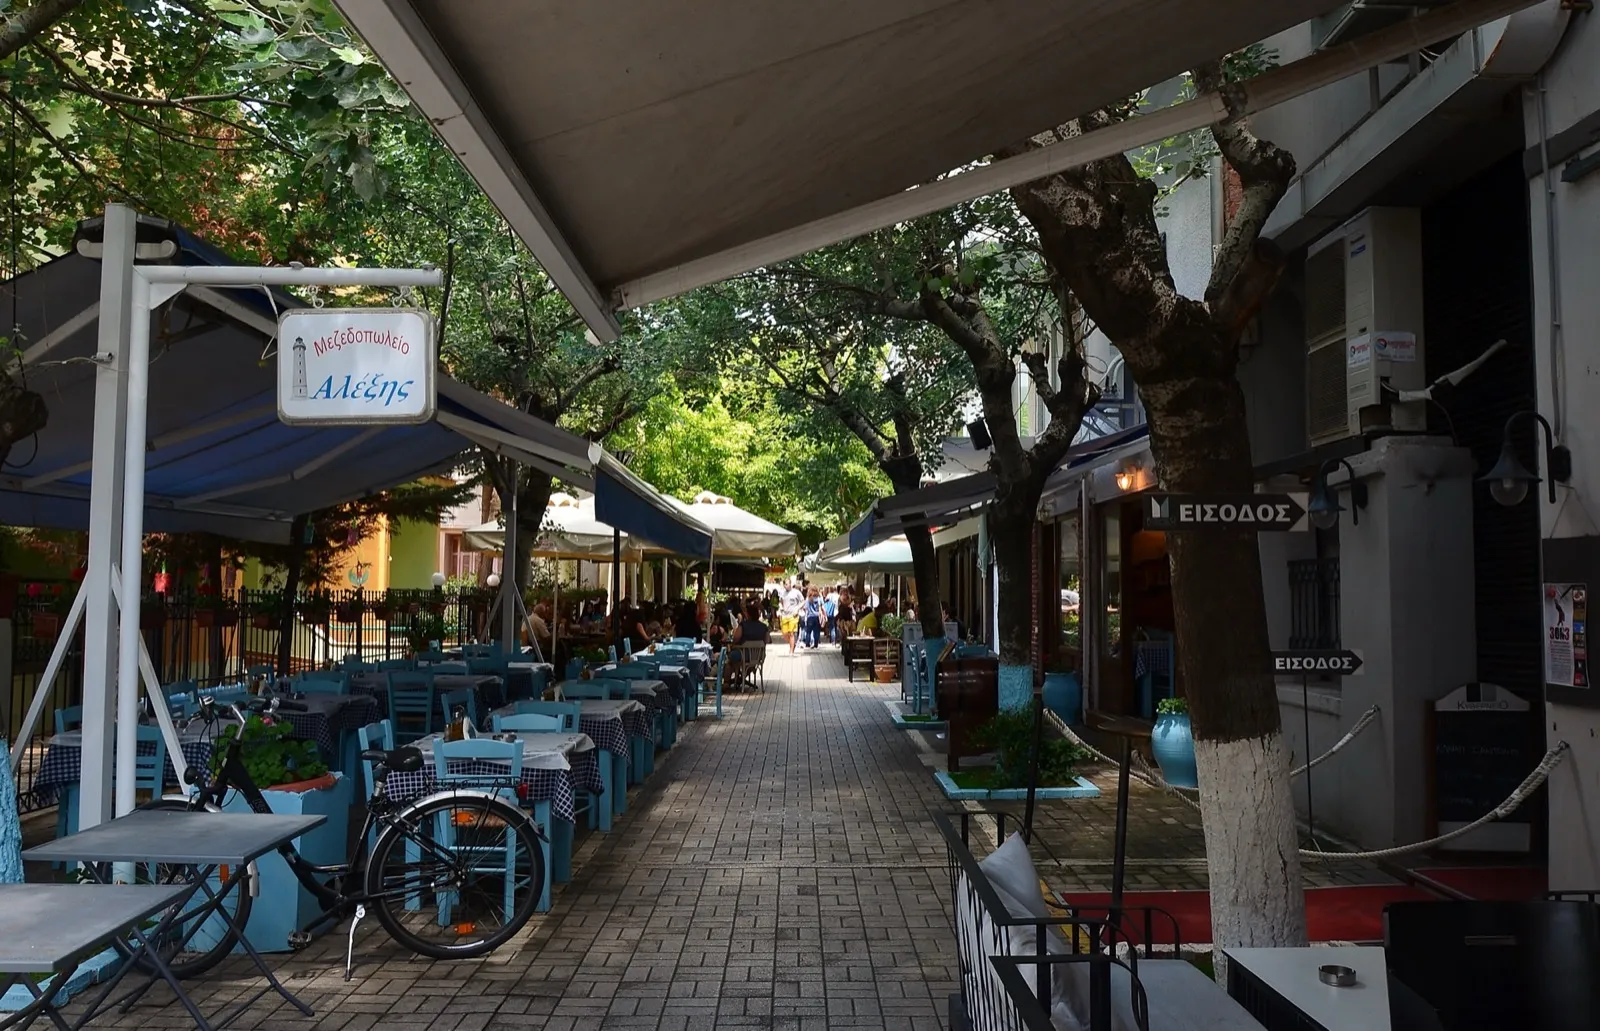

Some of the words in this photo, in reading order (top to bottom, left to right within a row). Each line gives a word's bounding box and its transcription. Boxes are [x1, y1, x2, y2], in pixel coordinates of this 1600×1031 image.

[313, 327, 410, 357] Μεζεδοπωλείο
[309, 373, 415, 407] Αλέξης
[1179, 503, 1291, 523] ΕΙΣΟΔΟΣ
[1275, 656, 1353, 670] ΕΙΣΟΔΟΣ
